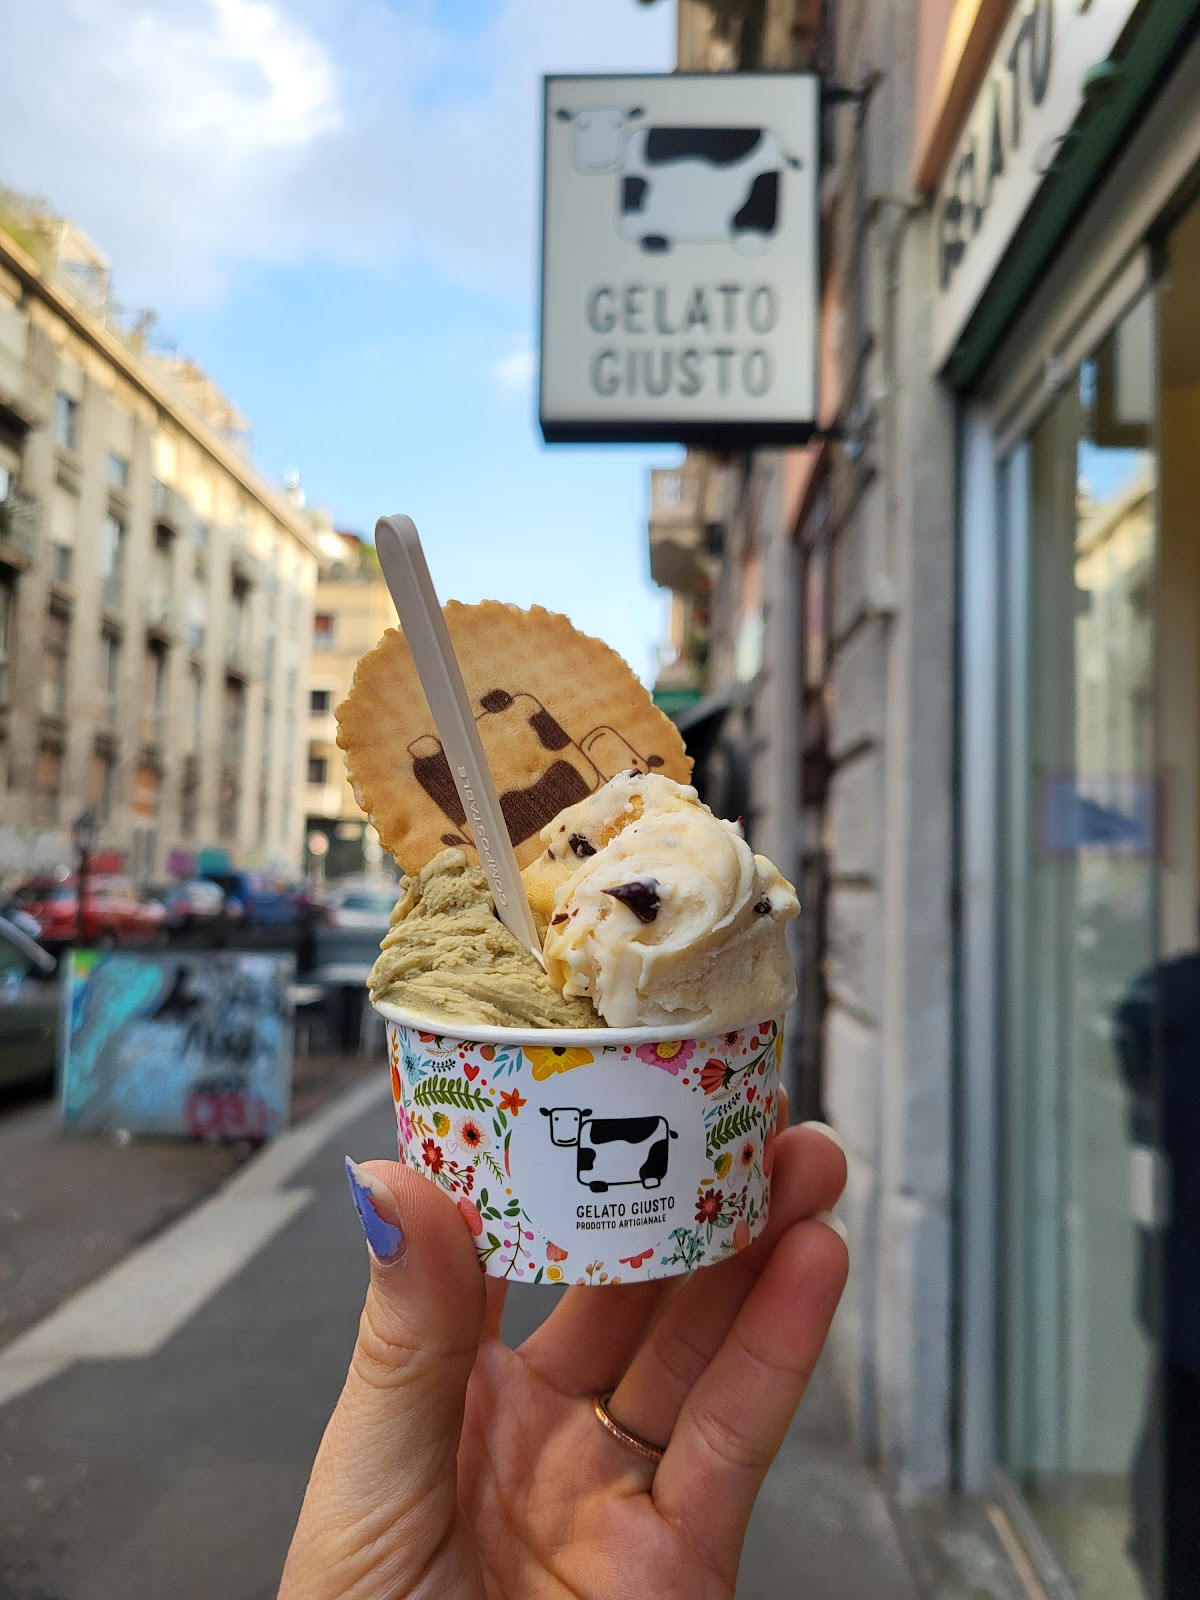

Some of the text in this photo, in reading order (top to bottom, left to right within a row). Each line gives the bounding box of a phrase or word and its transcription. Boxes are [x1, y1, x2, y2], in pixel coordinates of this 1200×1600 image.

[586, 283, 778, 336] GELATO
[589, 347, 775, 398] GIUSTO
[457, 765, 508, 907] COMPOSTABLE
[576, 1214, 666, 1230] PRODOTTO ARTIGIANALE
[577, 1196, 675, 1218] GELATO GIUSTO
